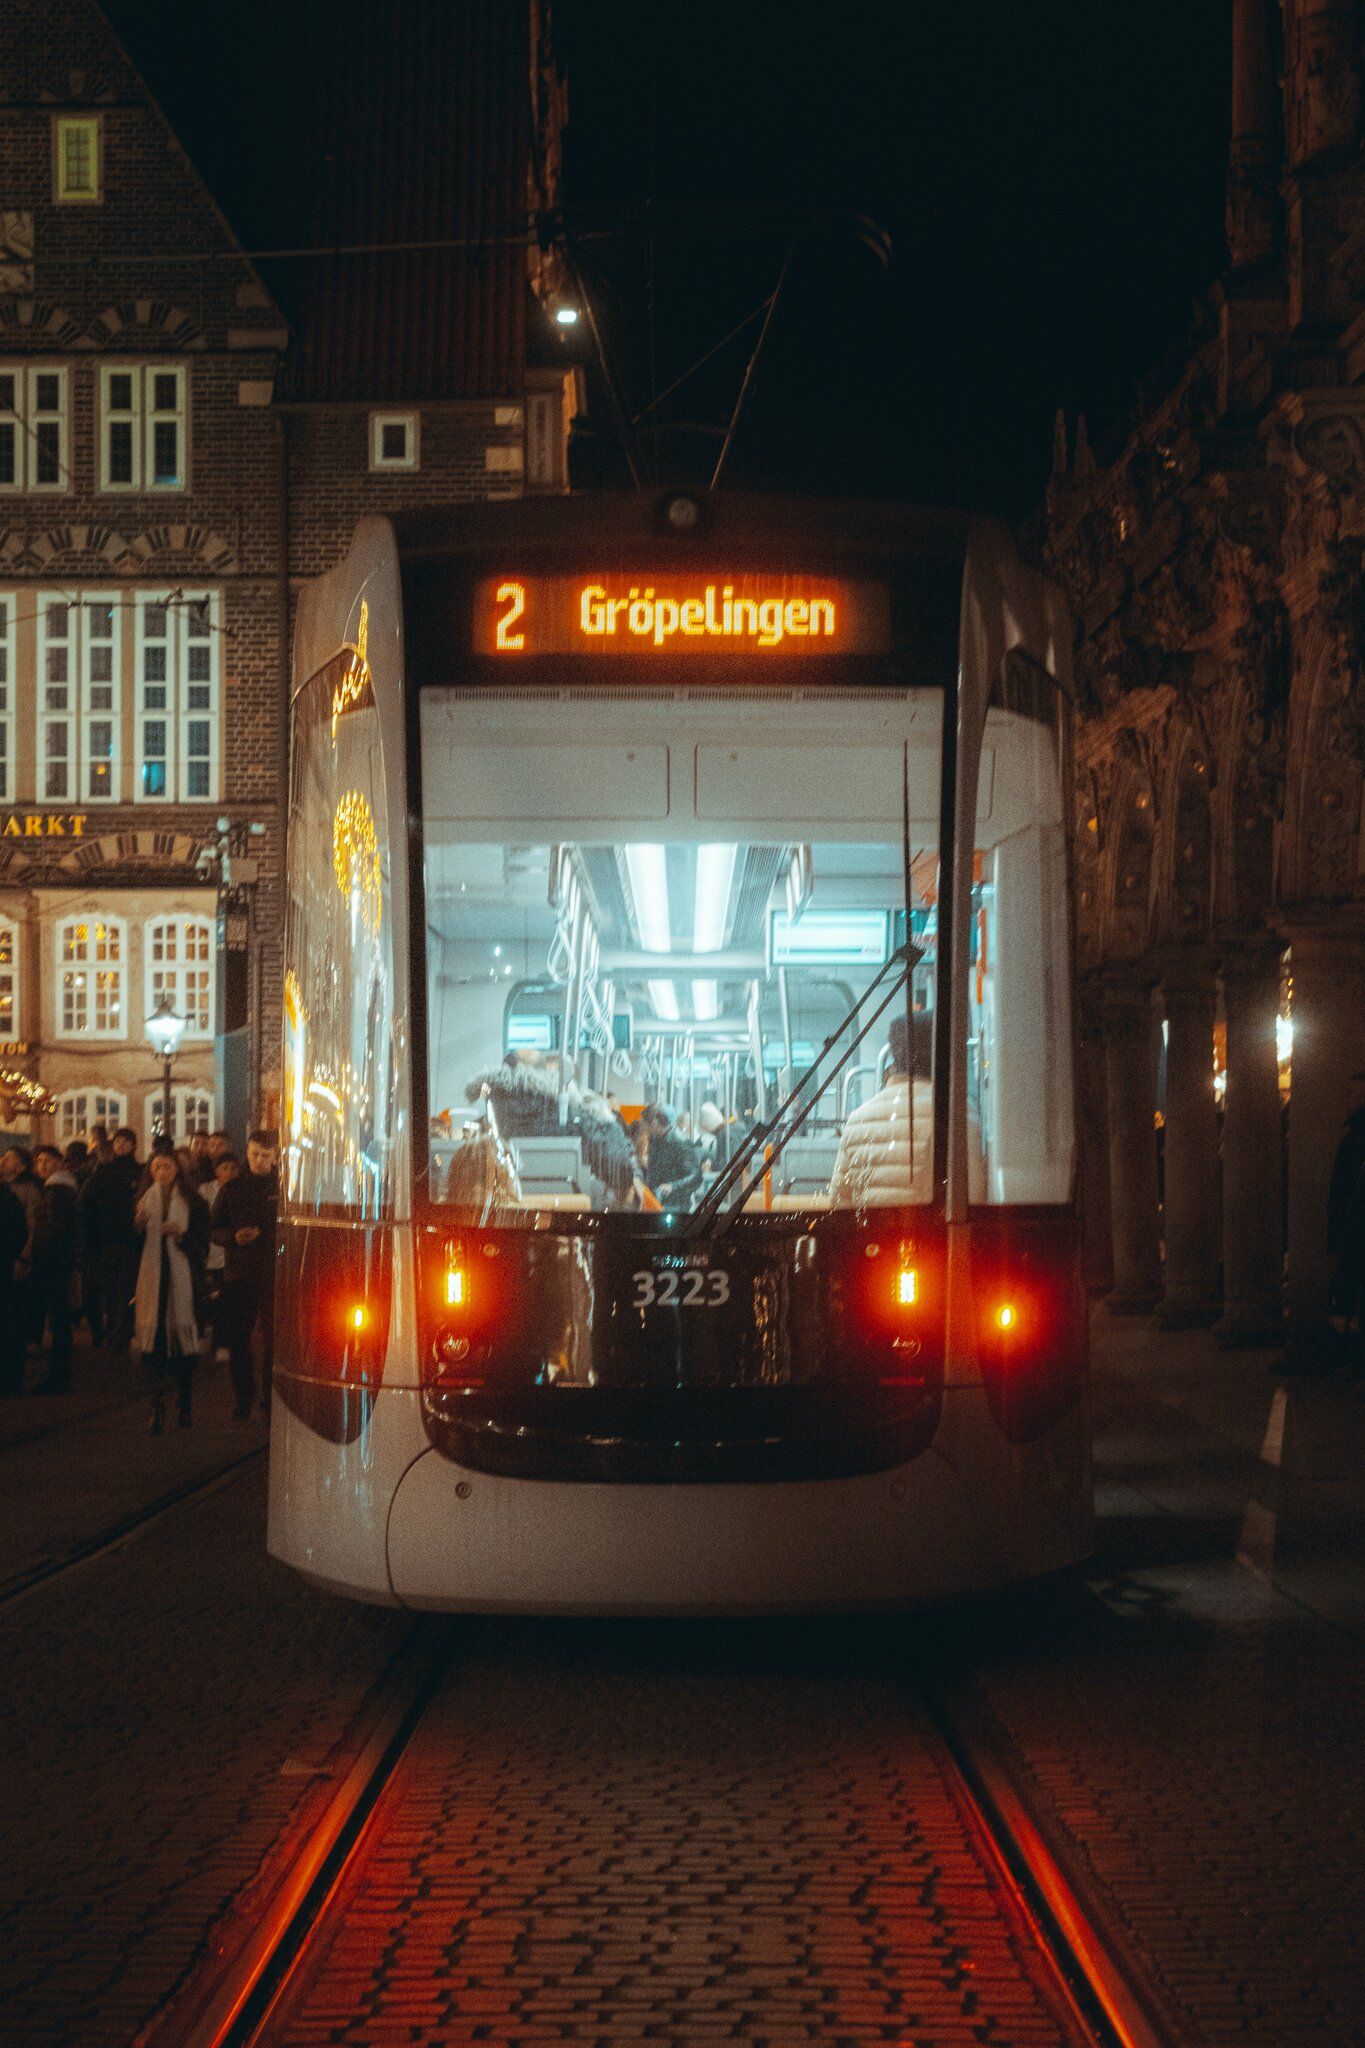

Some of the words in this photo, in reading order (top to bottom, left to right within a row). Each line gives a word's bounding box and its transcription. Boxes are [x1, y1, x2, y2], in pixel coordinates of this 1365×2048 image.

[496, 583, 525, 650] 2
[580, 585, 835, 646] Gröpelingen
[3, 815, 87, 836] ARKT
[632, 1269, 730, 1308] 3223
